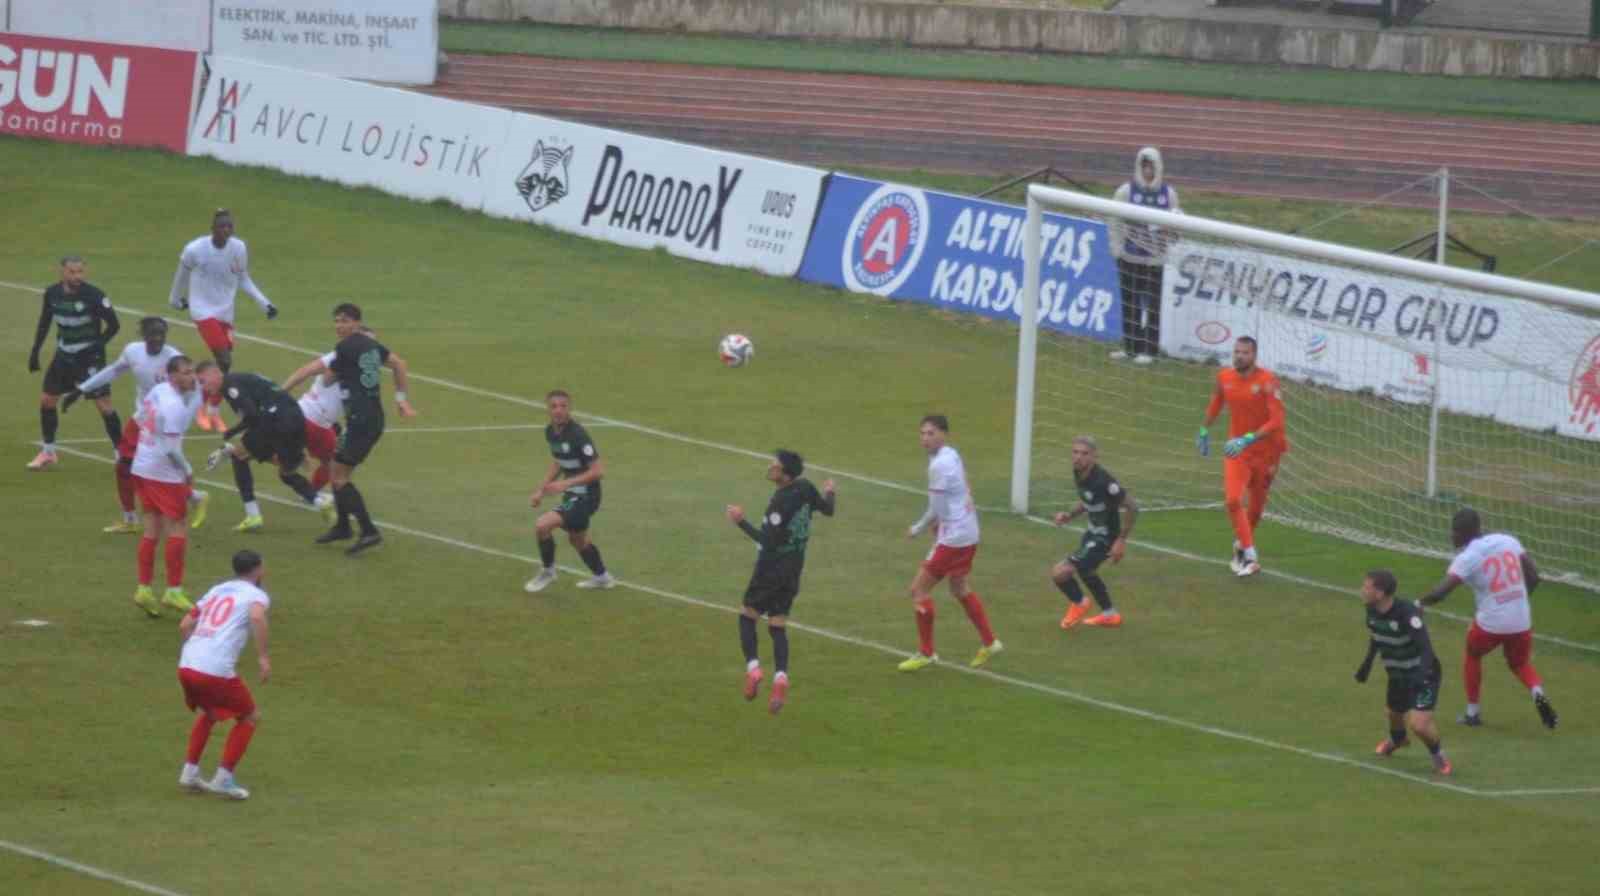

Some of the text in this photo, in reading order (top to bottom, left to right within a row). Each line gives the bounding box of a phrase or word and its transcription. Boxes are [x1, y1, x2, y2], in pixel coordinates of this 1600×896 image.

[251, 104, 490, 178] AVCI LOJİSTİK
[863, 217, 897, 265] A
[1482, 551, 1521, 593] 28
[203, 594, 236, 628] 10
